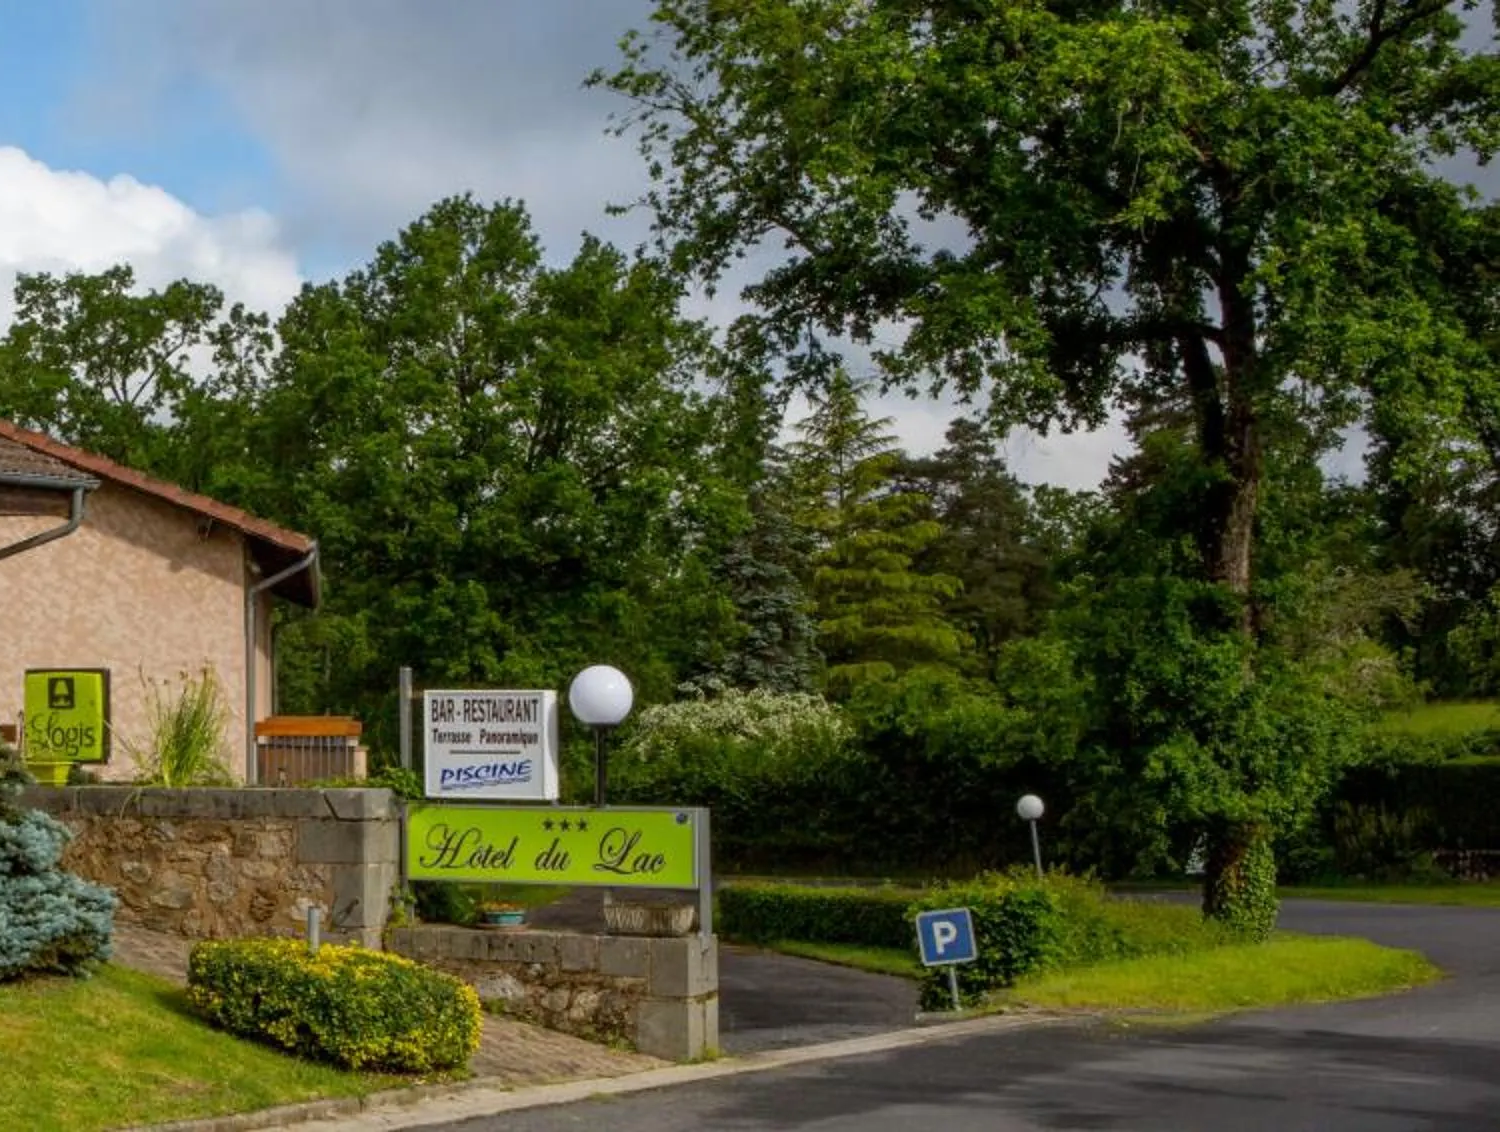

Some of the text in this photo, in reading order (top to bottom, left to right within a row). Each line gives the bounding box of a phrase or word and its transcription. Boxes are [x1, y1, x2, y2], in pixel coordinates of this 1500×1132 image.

[431, 699, 454, 722] BAR
[464, 699, 538, 723] RESTAURANT
[432, 729, 538, 748] Terrasse Panoramique
[440, 759, 533, 784] PISCINE
[419, 823, 666, 874] Hôtel du Lac
[931, 921, 957, 955] P
